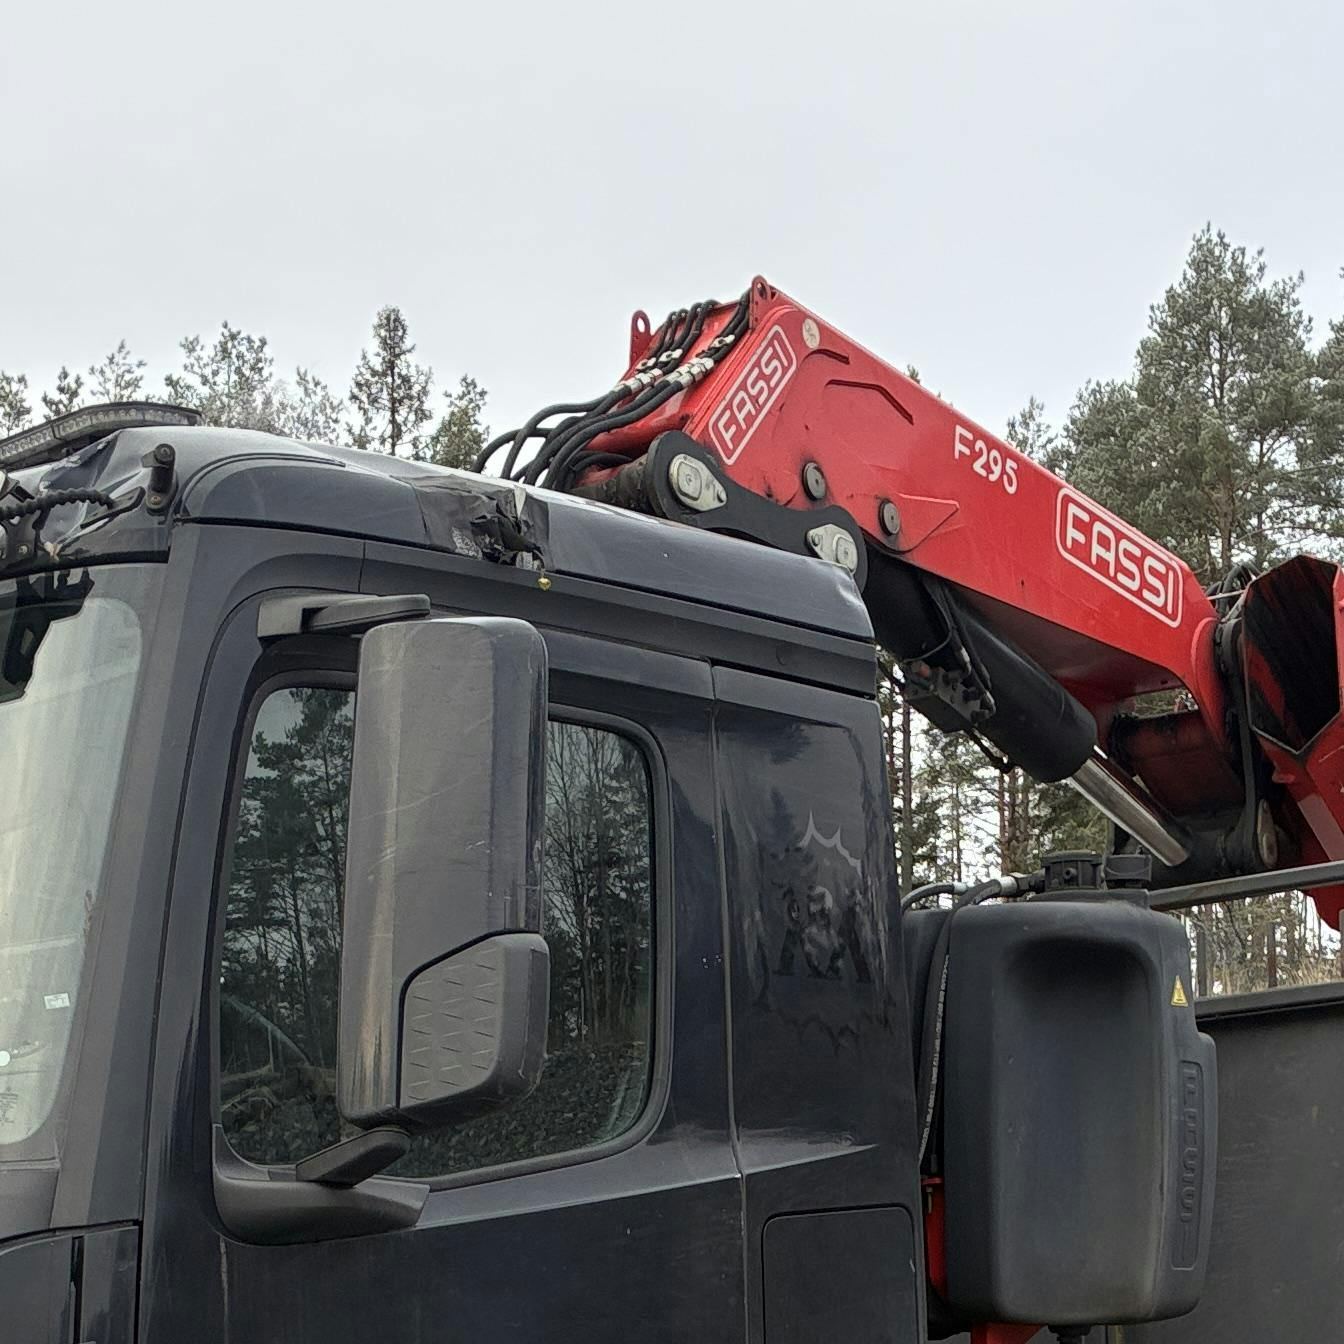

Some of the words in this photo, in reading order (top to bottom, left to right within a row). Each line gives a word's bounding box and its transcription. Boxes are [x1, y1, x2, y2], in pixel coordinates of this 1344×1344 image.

[717, 339, 789, 450] FASSI
[954, 424, 1018, 495] F295
[1065, 502, 1174, 615] FASSI
